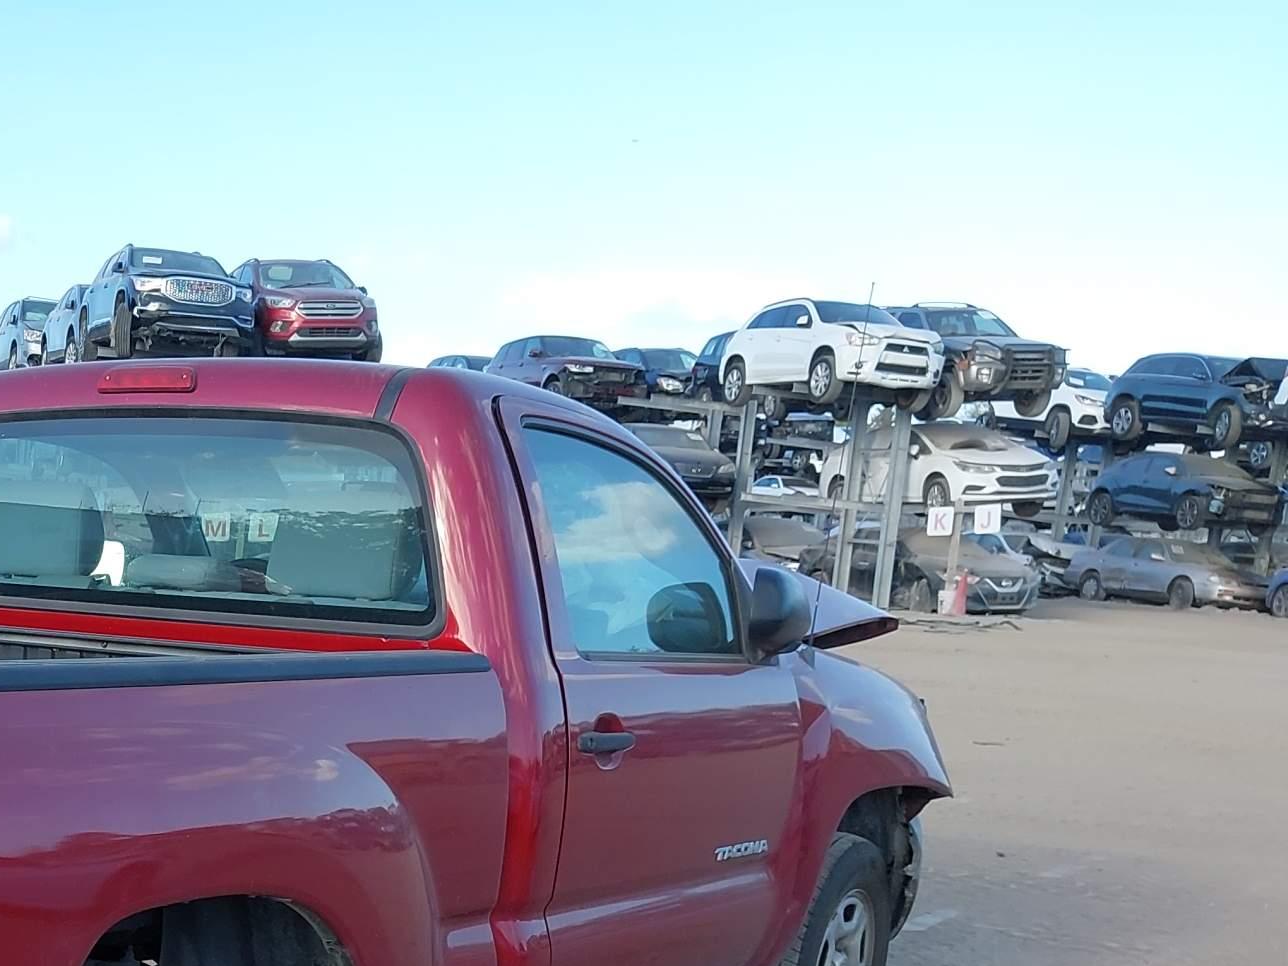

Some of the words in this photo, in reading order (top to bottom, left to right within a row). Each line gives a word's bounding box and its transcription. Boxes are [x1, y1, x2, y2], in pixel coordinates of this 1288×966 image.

[204, 519, 227, 537] M
[257, 519, 270, 537] L
[934, 513, 947, 531] K
[980, 511, 991, 529] J
[714, 839, 769, 861] TACOMA
